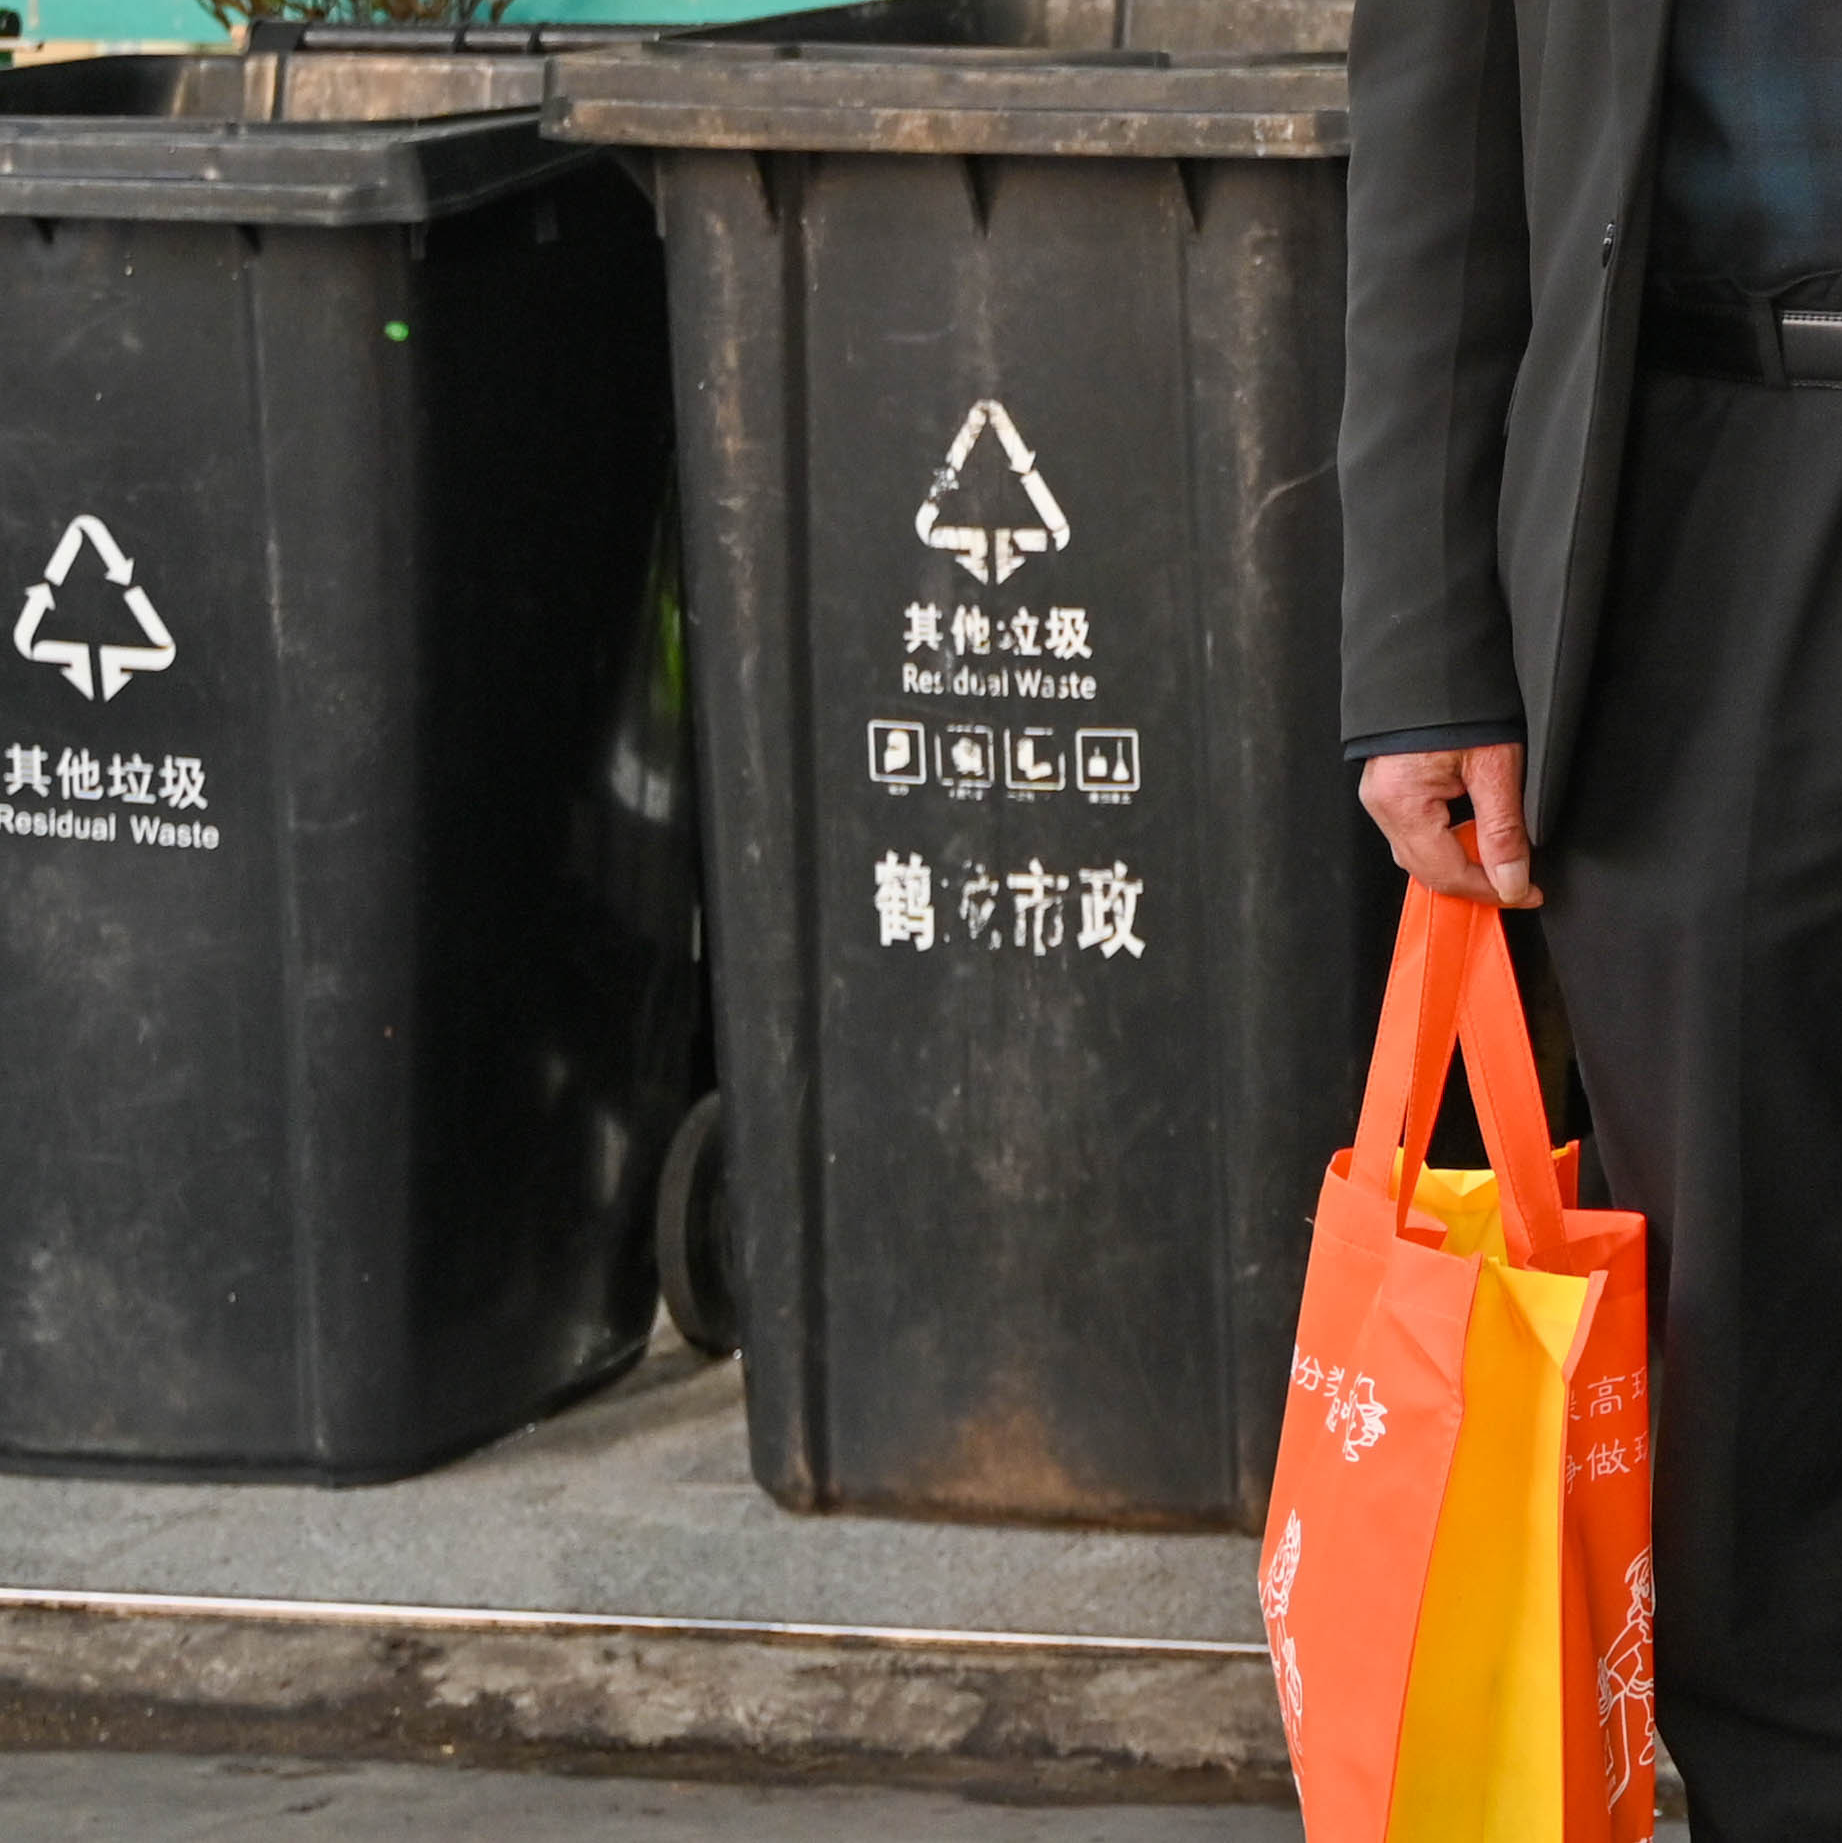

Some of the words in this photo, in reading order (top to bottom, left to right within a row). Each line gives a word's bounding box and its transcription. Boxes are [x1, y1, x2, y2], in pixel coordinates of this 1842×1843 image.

[1014, 668, 1098, 700] Waste
[4, 742, 208, 810] 其他垃圾
[0, 804, 117, 842] Residual
[130, 813, 221, 850] Waste
